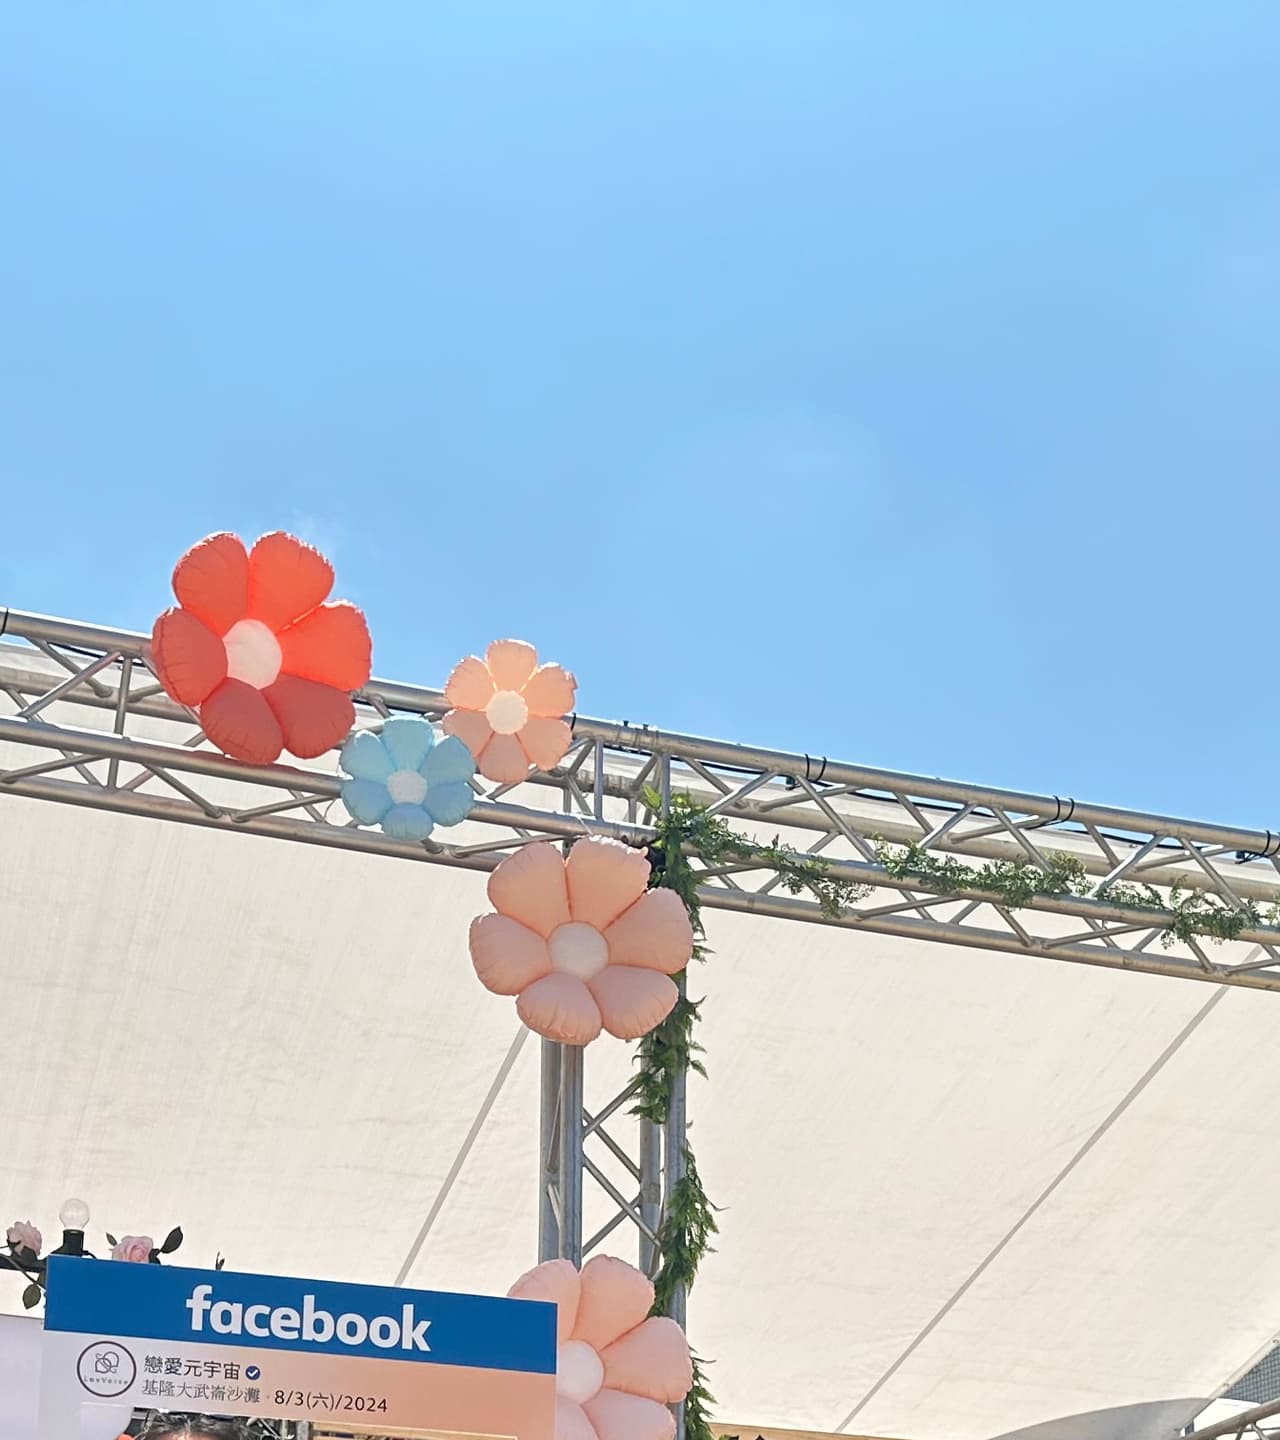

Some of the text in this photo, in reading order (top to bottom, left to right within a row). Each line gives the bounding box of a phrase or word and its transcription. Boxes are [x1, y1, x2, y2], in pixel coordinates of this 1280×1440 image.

[186, 1284, 432, 1352] facebook
[144, 1355, 241, 1381] 戀愛元宇宙
[142, 1379, 260, 1404] 基隆大武崙沙灘
[274, 1390, 388, 1414] 8/3(六)/2024
